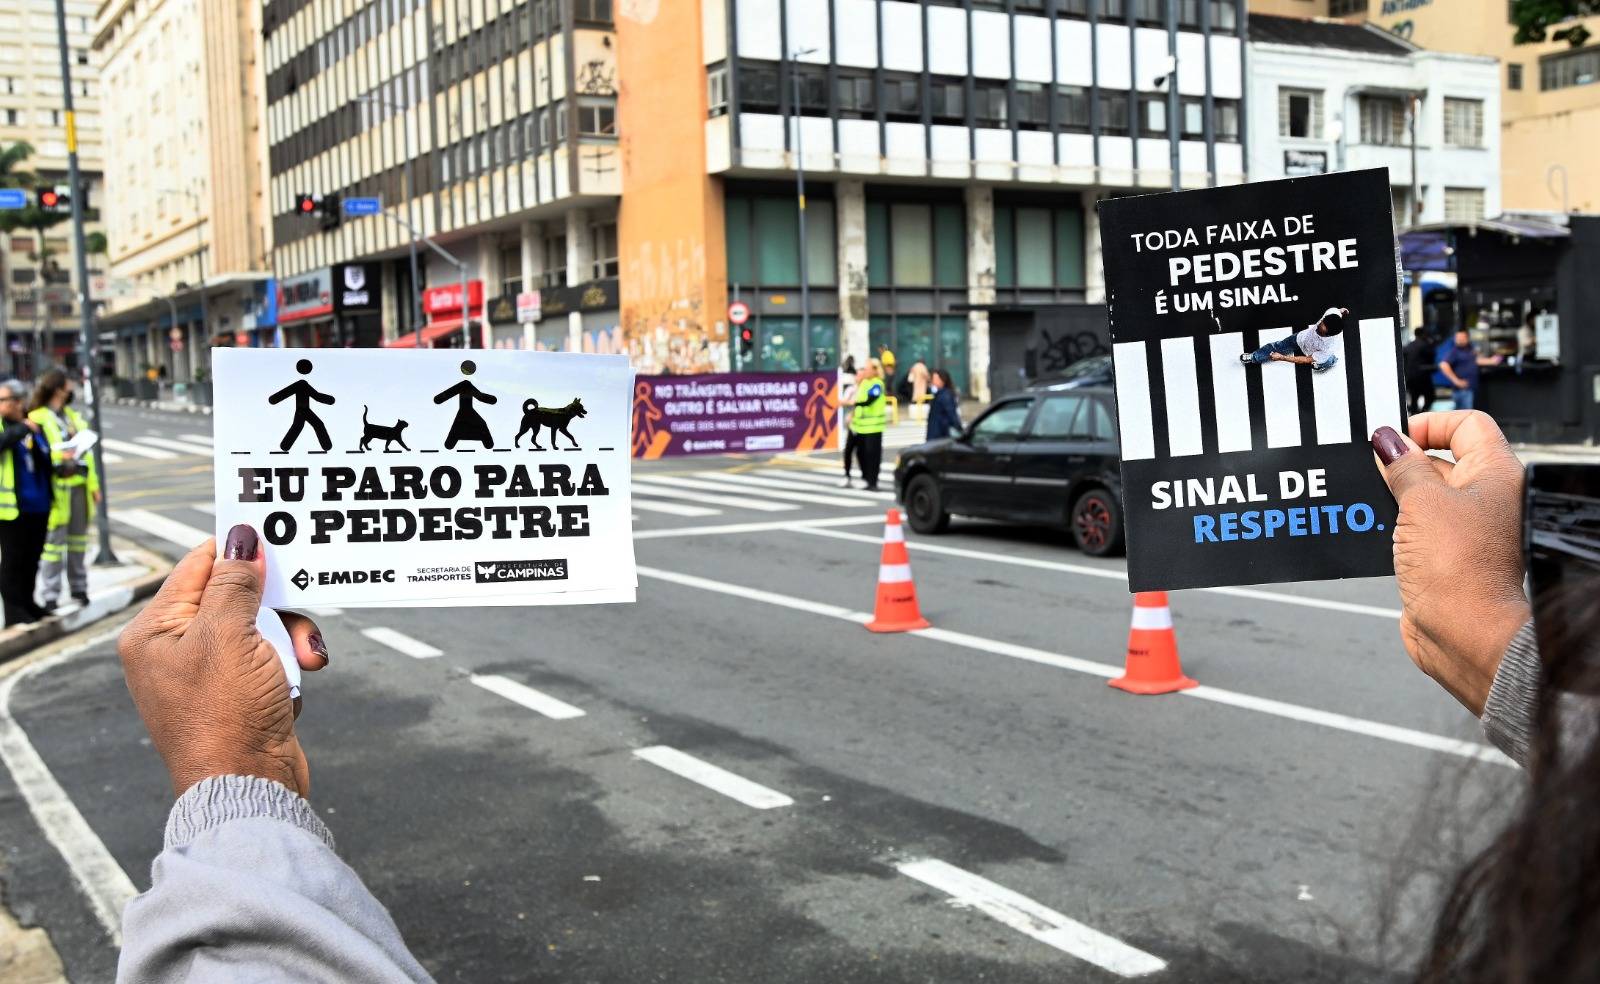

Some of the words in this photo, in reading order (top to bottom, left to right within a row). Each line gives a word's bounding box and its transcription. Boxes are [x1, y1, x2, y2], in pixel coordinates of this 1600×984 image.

[1131, 228, 1199, 252] TODA
[1207, 219, 1276, 244] FAIXA
[1284, 215, 1314, 235] DE
[1169, 239, 1358, 286] PEDESTRE
[1155, 290, 1168, 314] É
[1174, 291, 1213, 312] UM
[1219, 284, 1298, 307] SINAL.
[655, 384, 673, 398] NO
[674, 381, 734, 398] TRÂNSITO,
[799, 381, 808, 395] O
[664, 401, 704, 415] OUTRO
[706, 398, 715, 414] É
[716, 399, 761, 414] SALVAR
[239, 468, 308, 502] EU
[322, 466, 461, 501] PARO
[474, 464, 609, 498] PARA
[1151, 474, 1268, 509] SINAL
[1279, 469, 1327, 499] DE
[264, 512, 297, 545] O
[311, 505, 589, 544] PEDESTRE
[1194, 503, 1384, 543] RESPEITO.
[319, 570, 395, 585] EMDEC
[407, 574, 471, 582] TRANSPORTES
[497, 567, 564, 579] CAMPINAS
